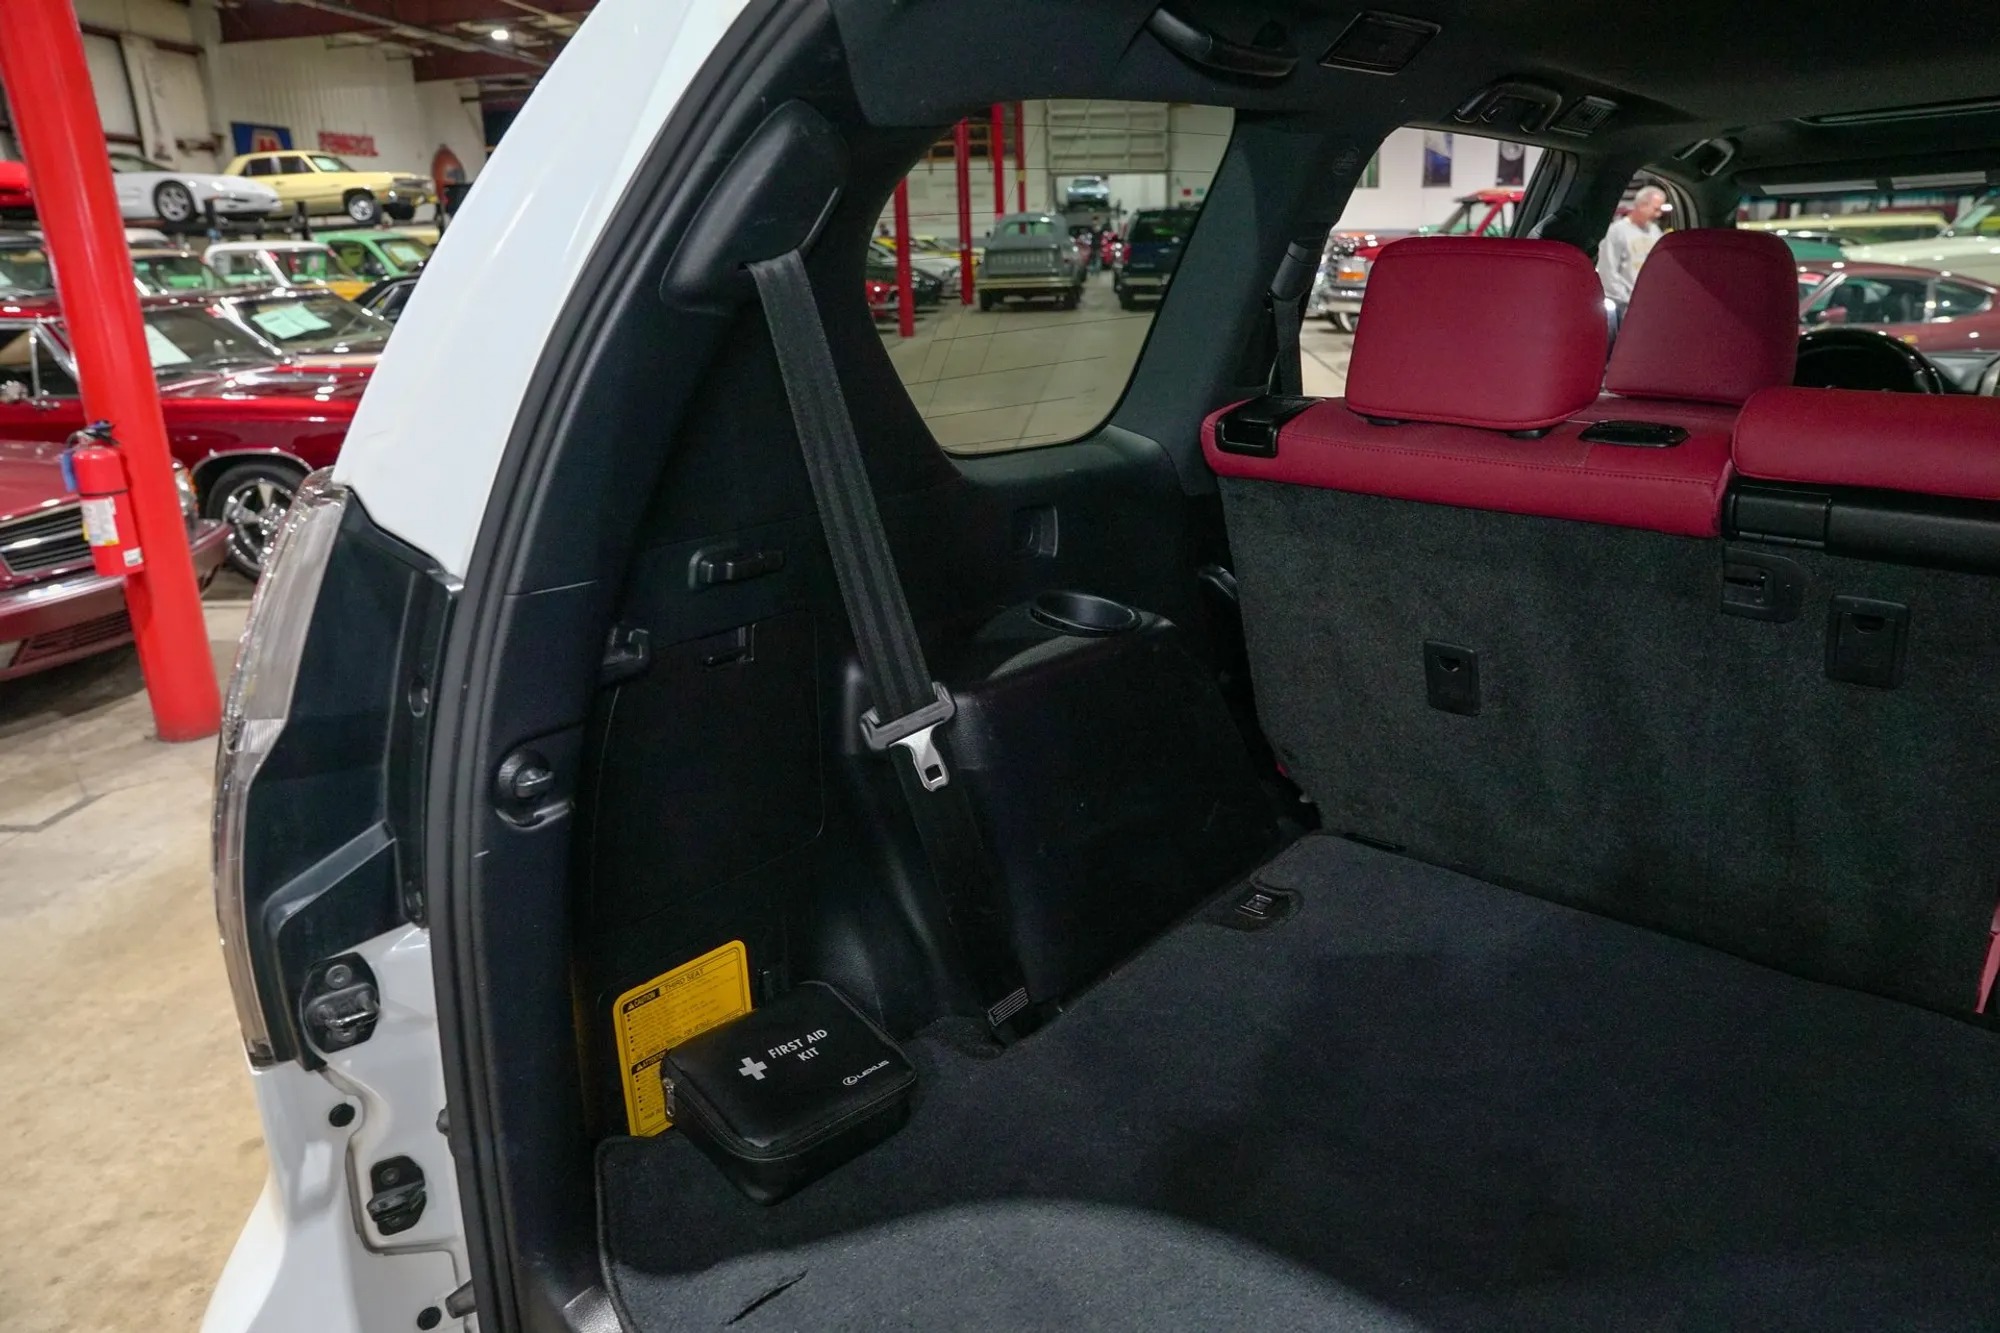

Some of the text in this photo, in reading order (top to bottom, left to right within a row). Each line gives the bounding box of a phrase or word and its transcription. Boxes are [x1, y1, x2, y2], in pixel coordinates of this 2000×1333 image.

[633, 990, 656, 1007] CAUTION
[687, 967, 704, 984] SEAT
[768, 1029, 828, 1059] FIRST AID
[797, 1047, 820, 1062] KIT
[856, 1060, 889, 1079] LEXUS
